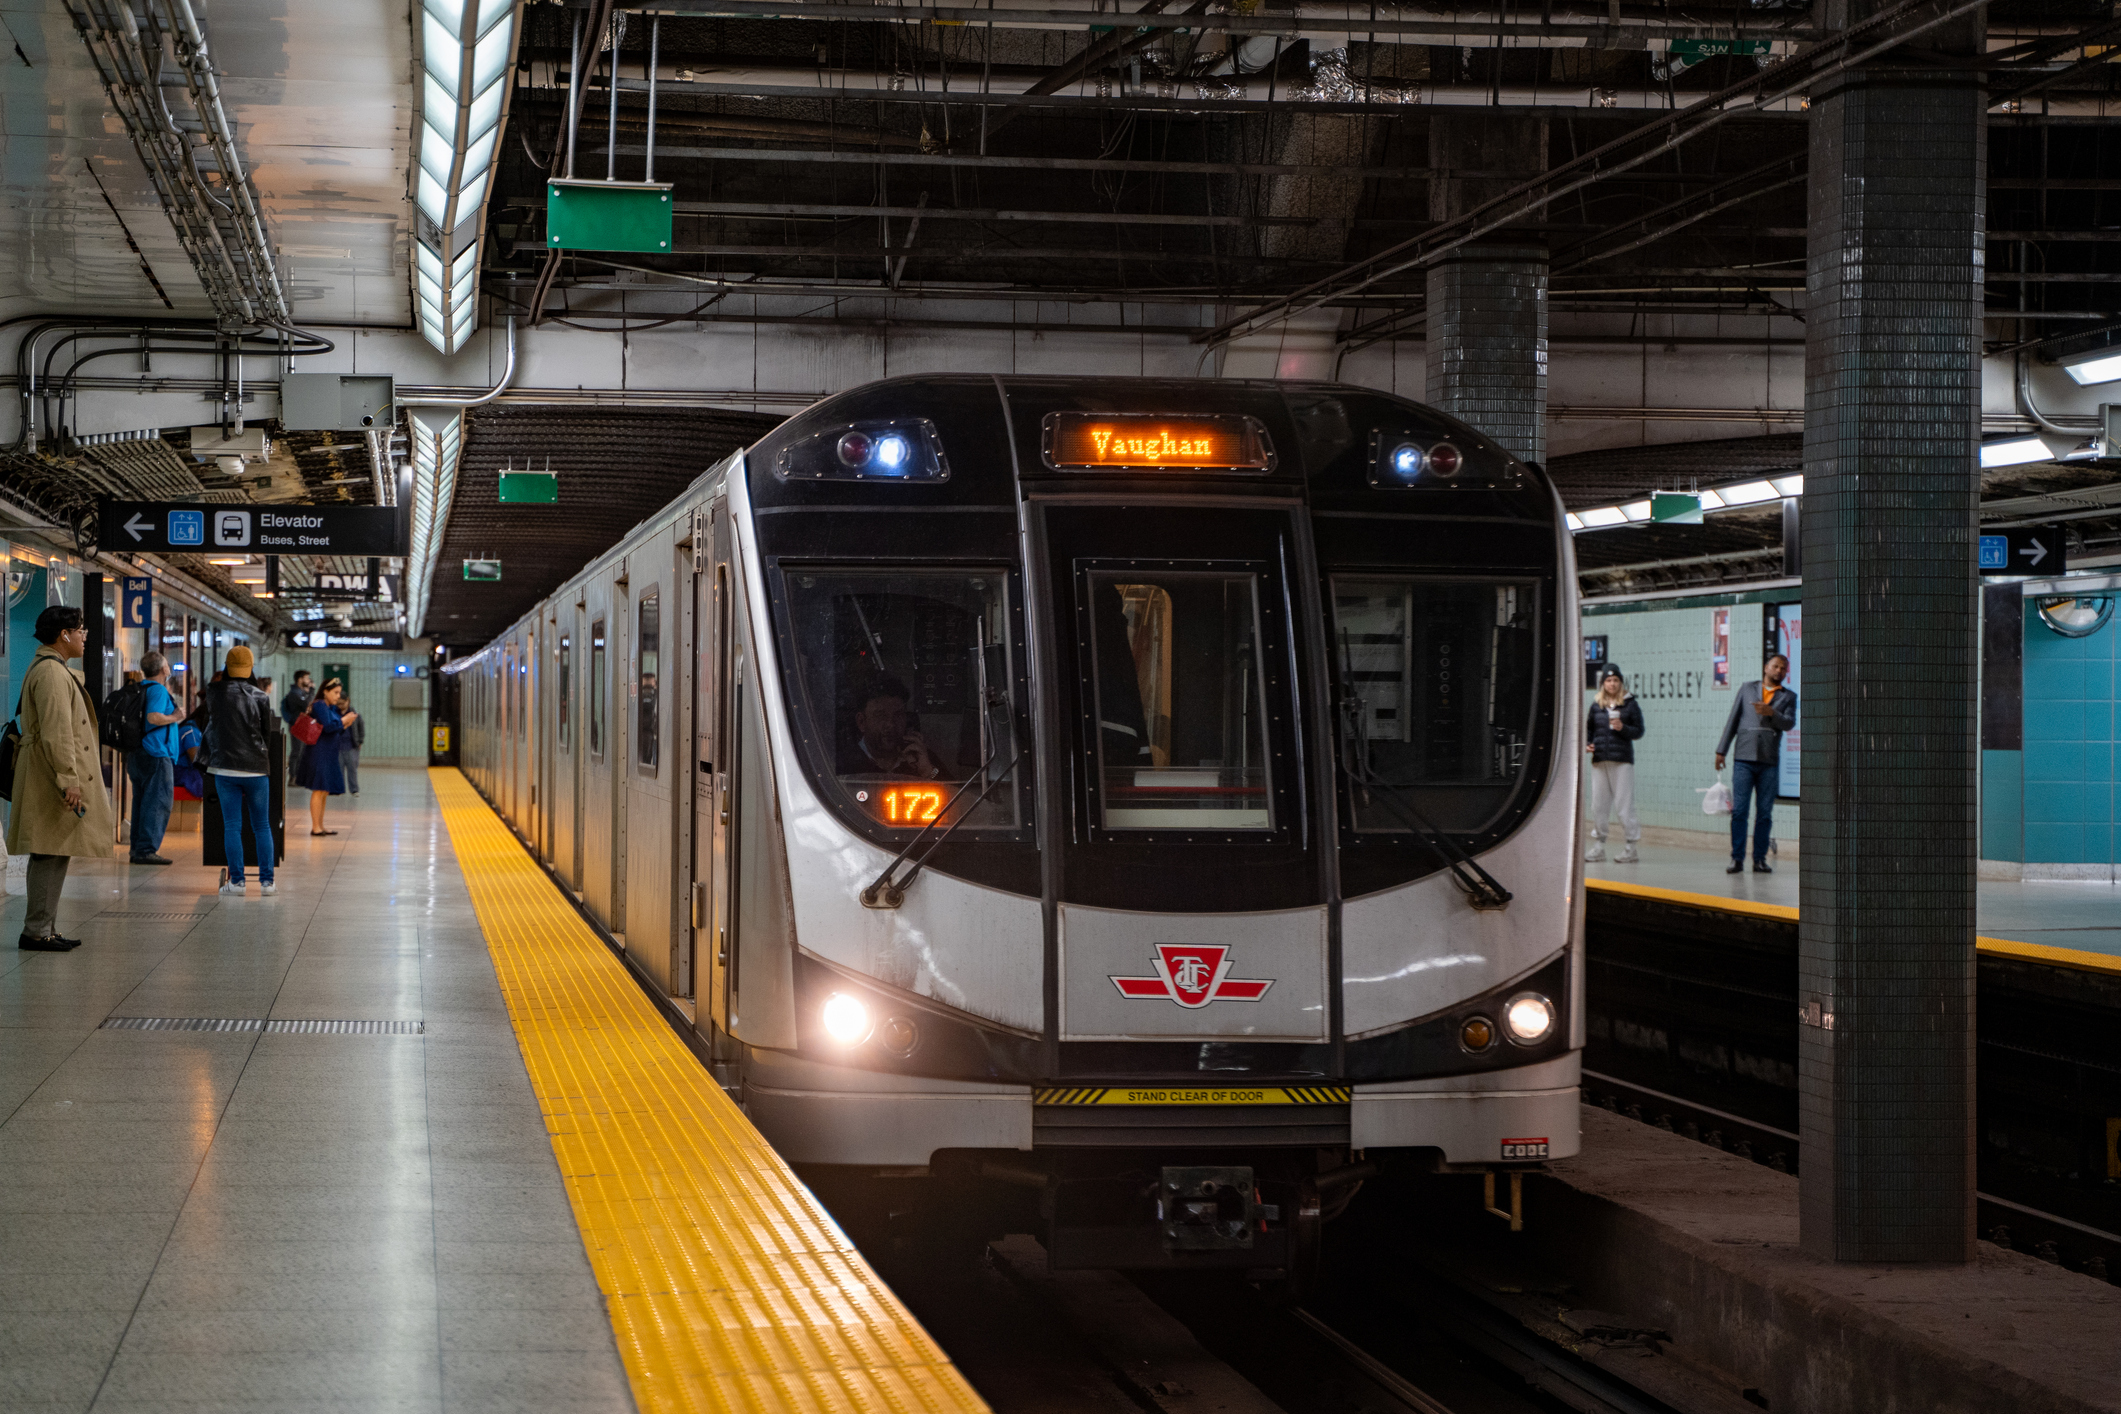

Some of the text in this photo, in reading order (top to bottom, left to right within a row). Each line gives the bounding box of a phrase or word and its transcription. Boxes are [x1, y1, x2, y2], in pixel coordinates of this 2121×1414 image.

[1091, 431, 1212, 460] Vaughan
[260, 513, 323, 528] Elevator
[260, 535, 330, 546] Buses, Street
[128, 580, 147, 591] Bell
[886, 791, 940, 820] 172
[1127, 1091, 1264, 1101] STAND CLEAR OF DOOR
